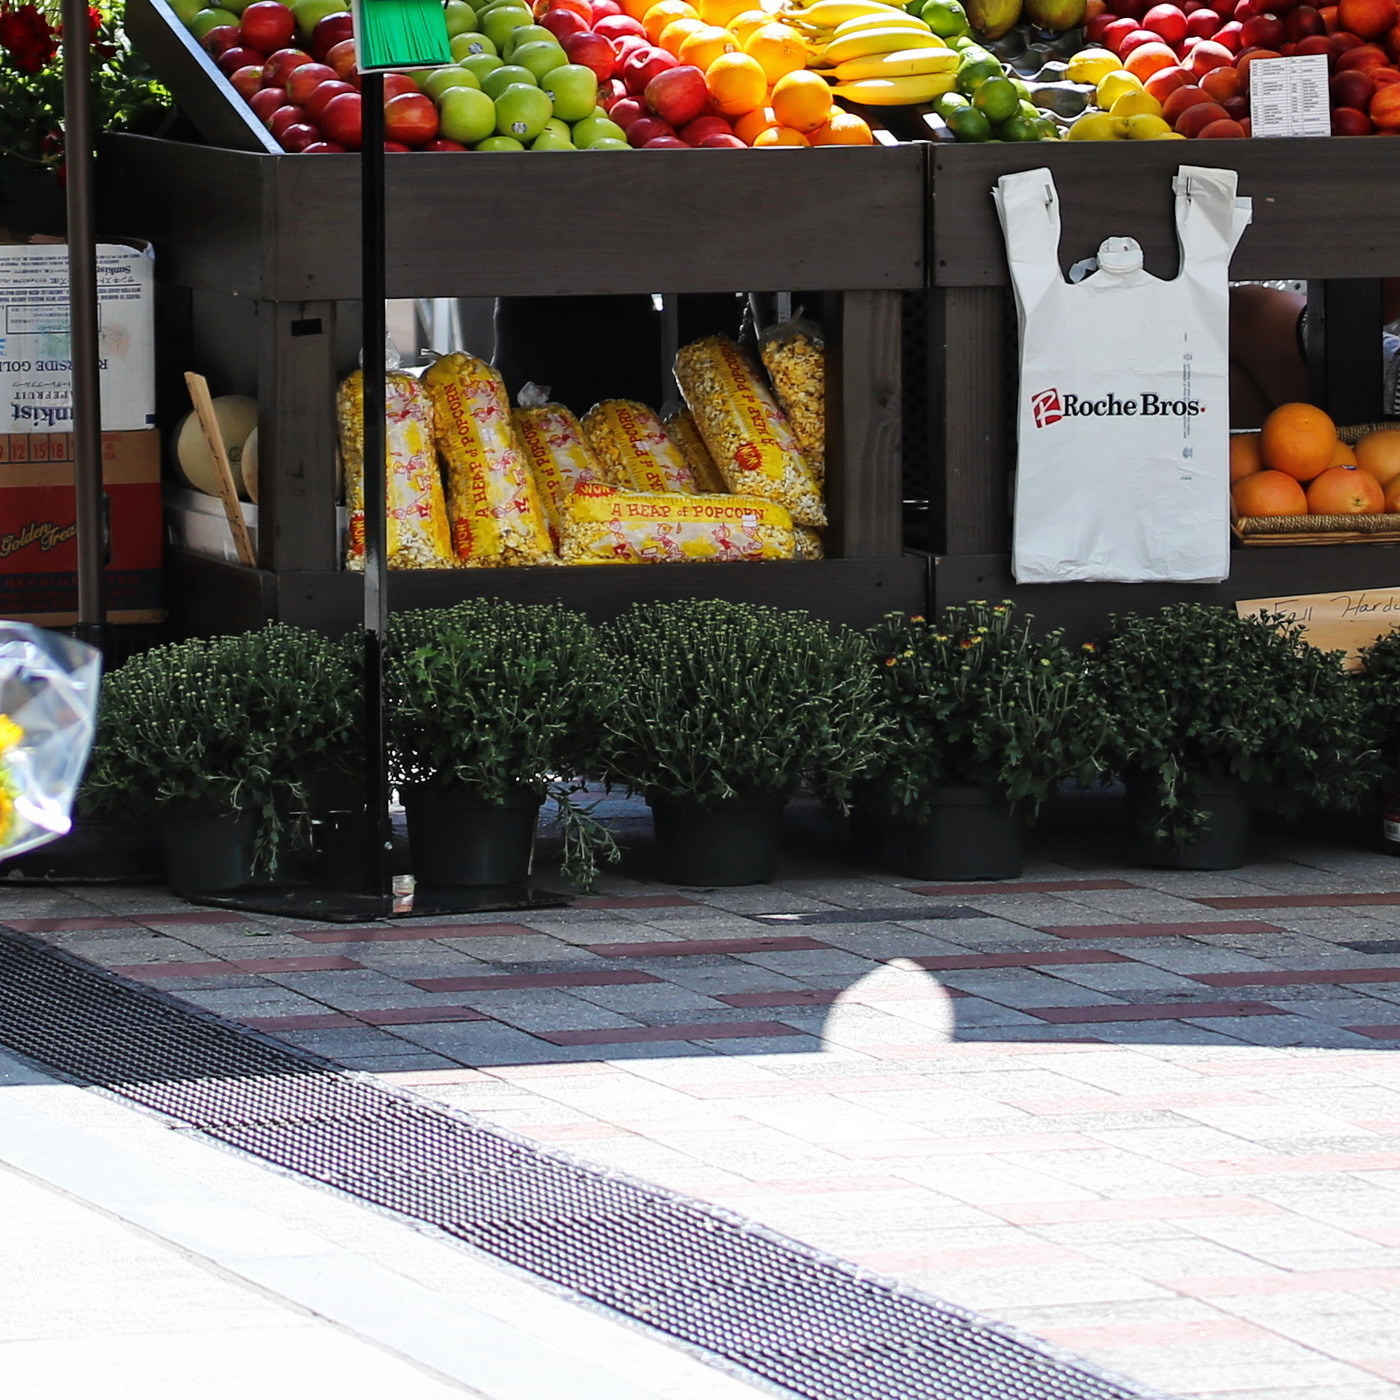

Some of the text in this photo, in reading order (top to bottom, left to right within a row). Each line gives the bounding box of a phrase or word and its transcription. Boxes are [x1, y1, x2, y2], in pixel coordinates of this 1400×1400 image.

[444, 382, 476, 443] POPCORN
[1062, 392, 1137, 417] Roche
[1140, 393, 1206, 416] Bros.
[748, 406, 770, 436] HEAP
[11, 444, 25, 460] 12
[33, 443, 46, 459] 15
[51, 443, 64, 459] 18
[466, 446, 480, 458] of
[470, 461, 487, 502] HEAP
[611, 503, 765, 521] A HEAP of POPCORN
[0, 521, 77, 557] Golden Trea
[1274, 599, 1314, 623] Fall
